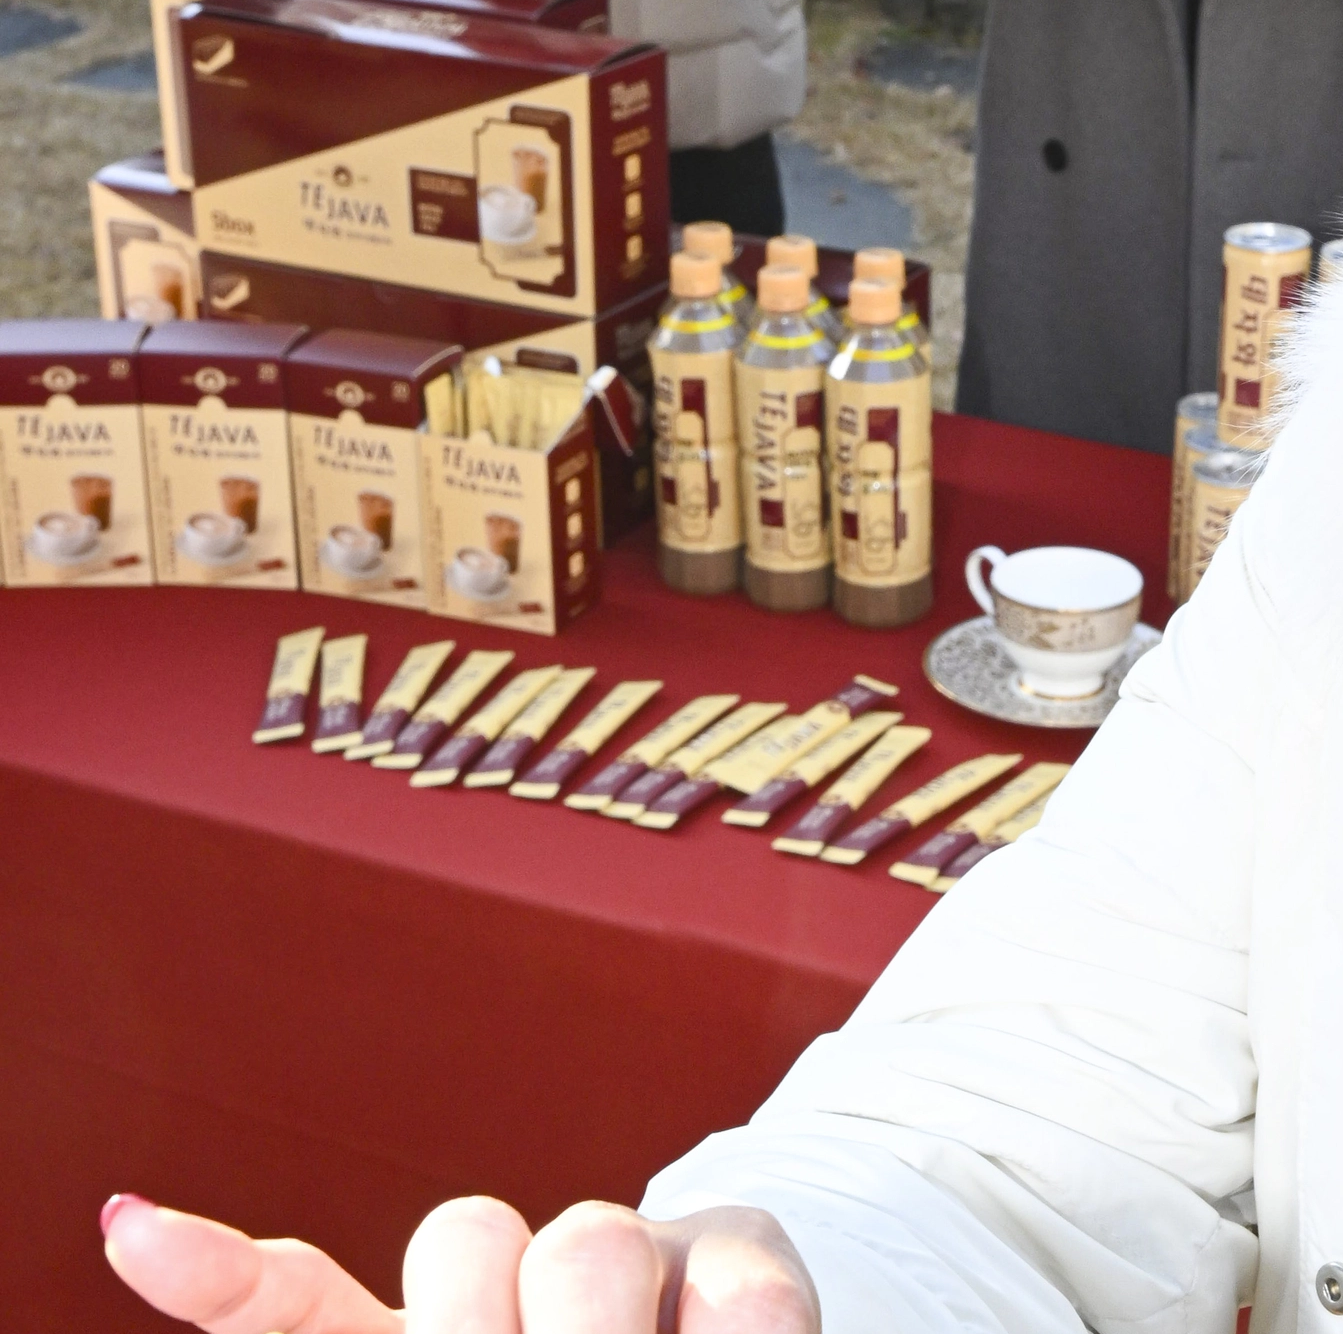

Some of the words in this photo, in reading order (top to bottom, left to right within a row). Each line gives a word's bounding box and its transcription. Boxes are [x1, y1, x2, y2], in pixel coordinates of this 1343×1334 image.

[300, 180, 390, 229] TEJAVA
[1232, 275, 1268, 365] 데자와
[17, 414, 113, 443] TEJAVA
[169, 414, 260, 444] TEJAVA
[313, 424, 394, 463] TEJAVA
[754, 389, 789, 492] TEJAVA
[442, 444, 522, 484] TEJAVA
